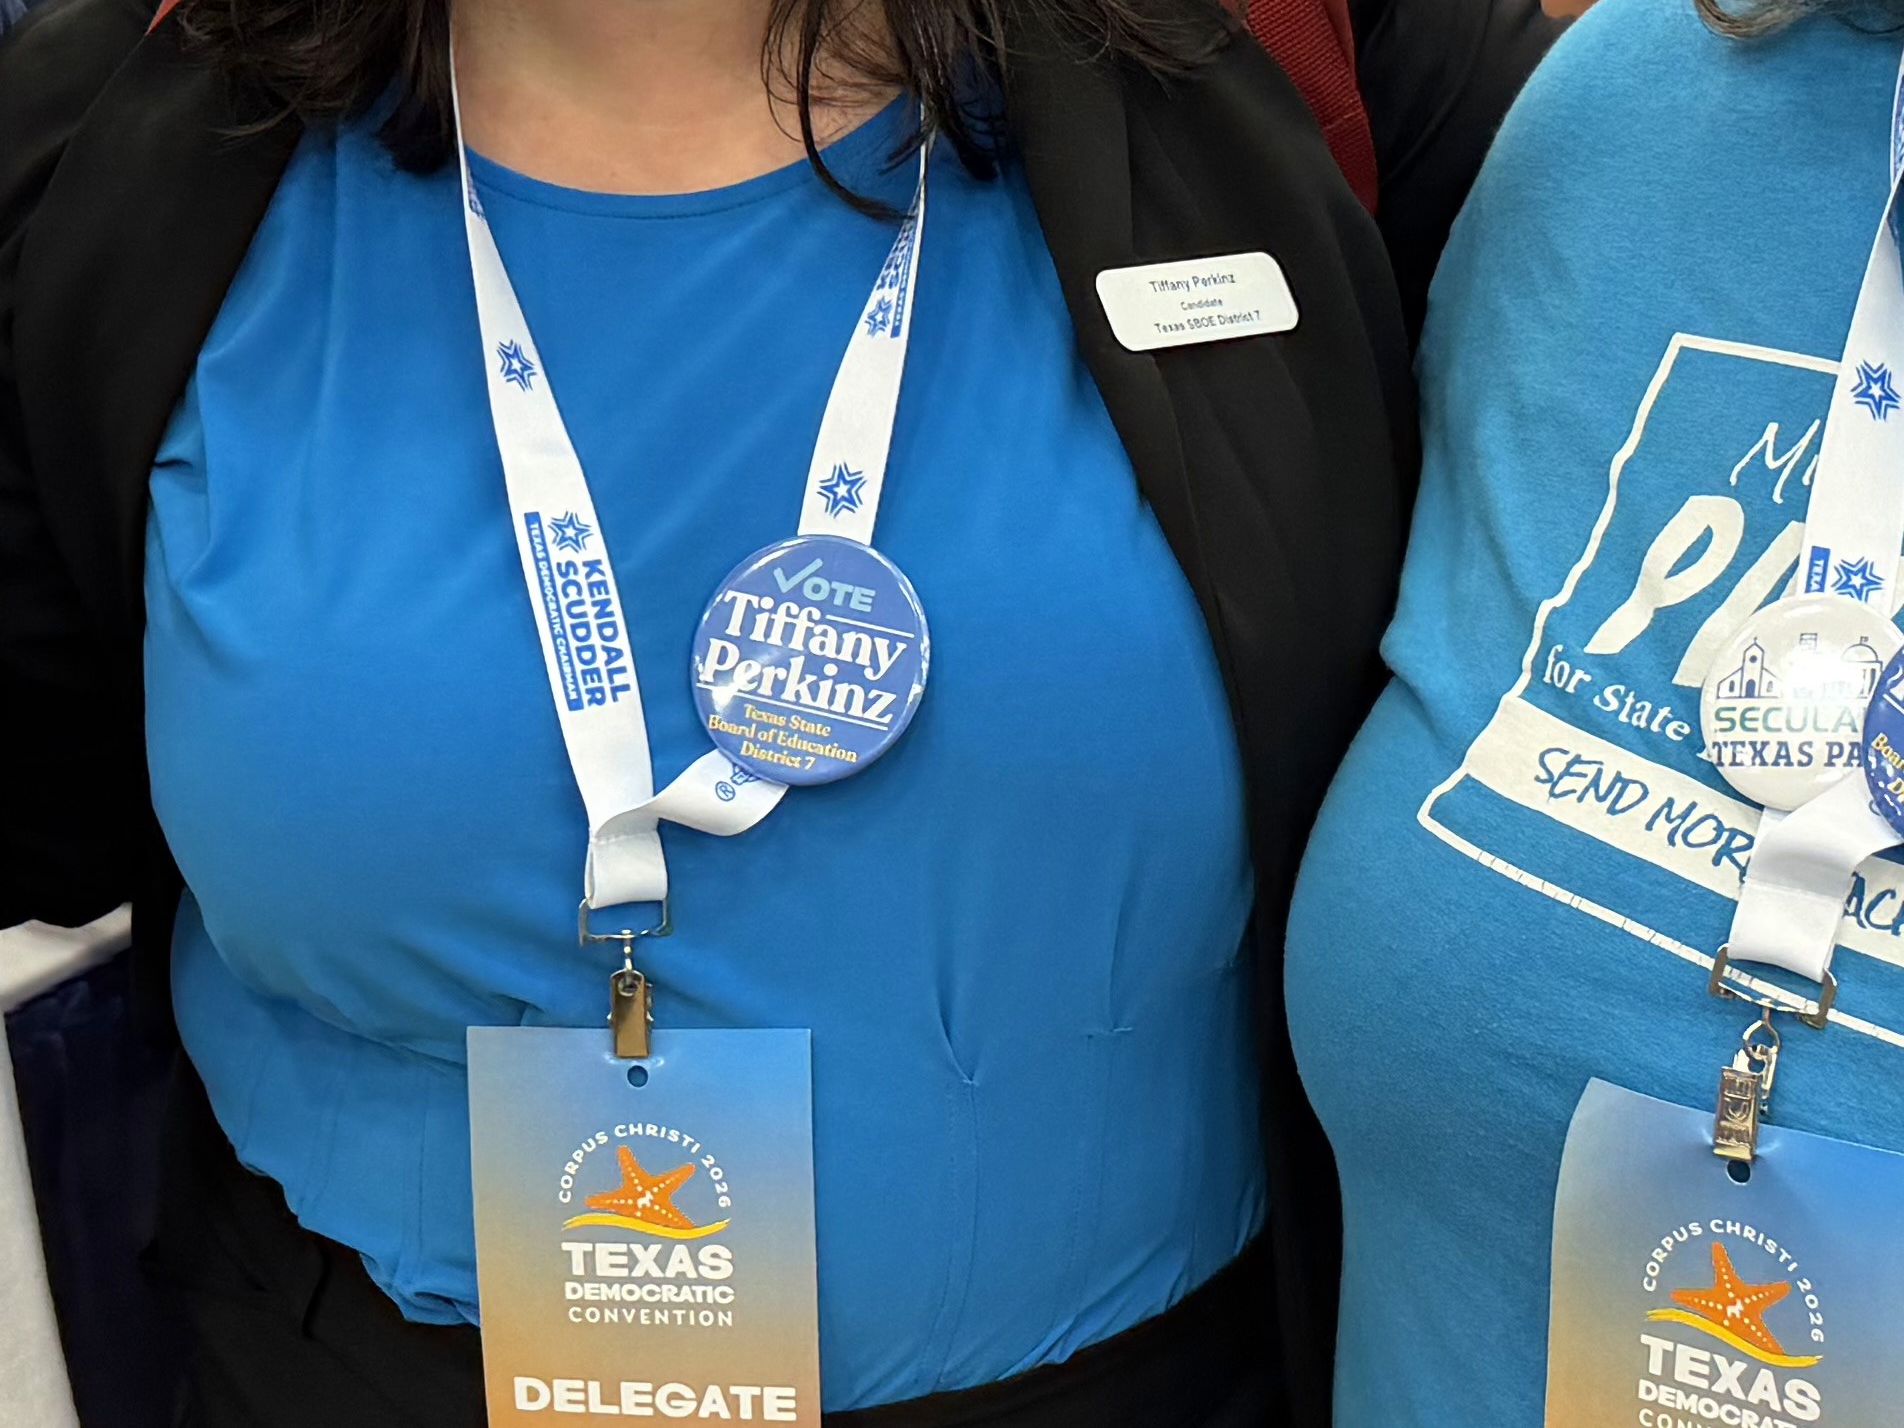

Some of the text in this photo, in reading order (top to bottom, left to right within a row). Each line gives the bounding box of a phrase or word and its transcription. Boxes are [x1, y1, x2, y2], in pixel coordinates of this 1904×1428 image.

[1149, 279, 1190, 293] Tiffany
[1180, 297, 1223, 311] Candidate
[1154, 323, 1186, 334] Texas
[1188, 316, 1216, 331] SBOE
[1217, 311, 1254, 327] District
[773, 558, 876, 613] VOTE
[1810, 559, 1825, 591] TEXA
[529, 523, 578, 700] TEXAS DEMOCRATIC CHAIRMAN
[556, 560, 606, 707] SCUDDER
[582, 559, 631, 703] KENDALL
[724, 590, 907, 681] Tiffany
[699, 638, 897, 723] Perkinz
[1543, 645, 1691, 742] for State
[709, 715, 857, 763] Board of Education
[744, 703, 831, 737] Texas State
[1714, 706, 1867, 733] SECULA
[741, 741, 816, 770] District 7
[1712, 740, 1814, 768] TEXAS
[1533, 746, 1649, 816] SEND
[1652, 799, 1755, 884] MOR
[559, 1123, 732, 1208] CORPUS CHRISTI 2026
[561, 1242, 734, 1280] TEXAS
[1643, 1219, 1825, 1343] CORPUS CHRISTI 2026
[565, 1282, 735, 1304] DEMOCRATIC
[568, 1307, 733, 1326] CONVENTION
[514, 1377, 797, 1421] DELEGATE
[1640, 1334, 1821, 1421] TEXAS
